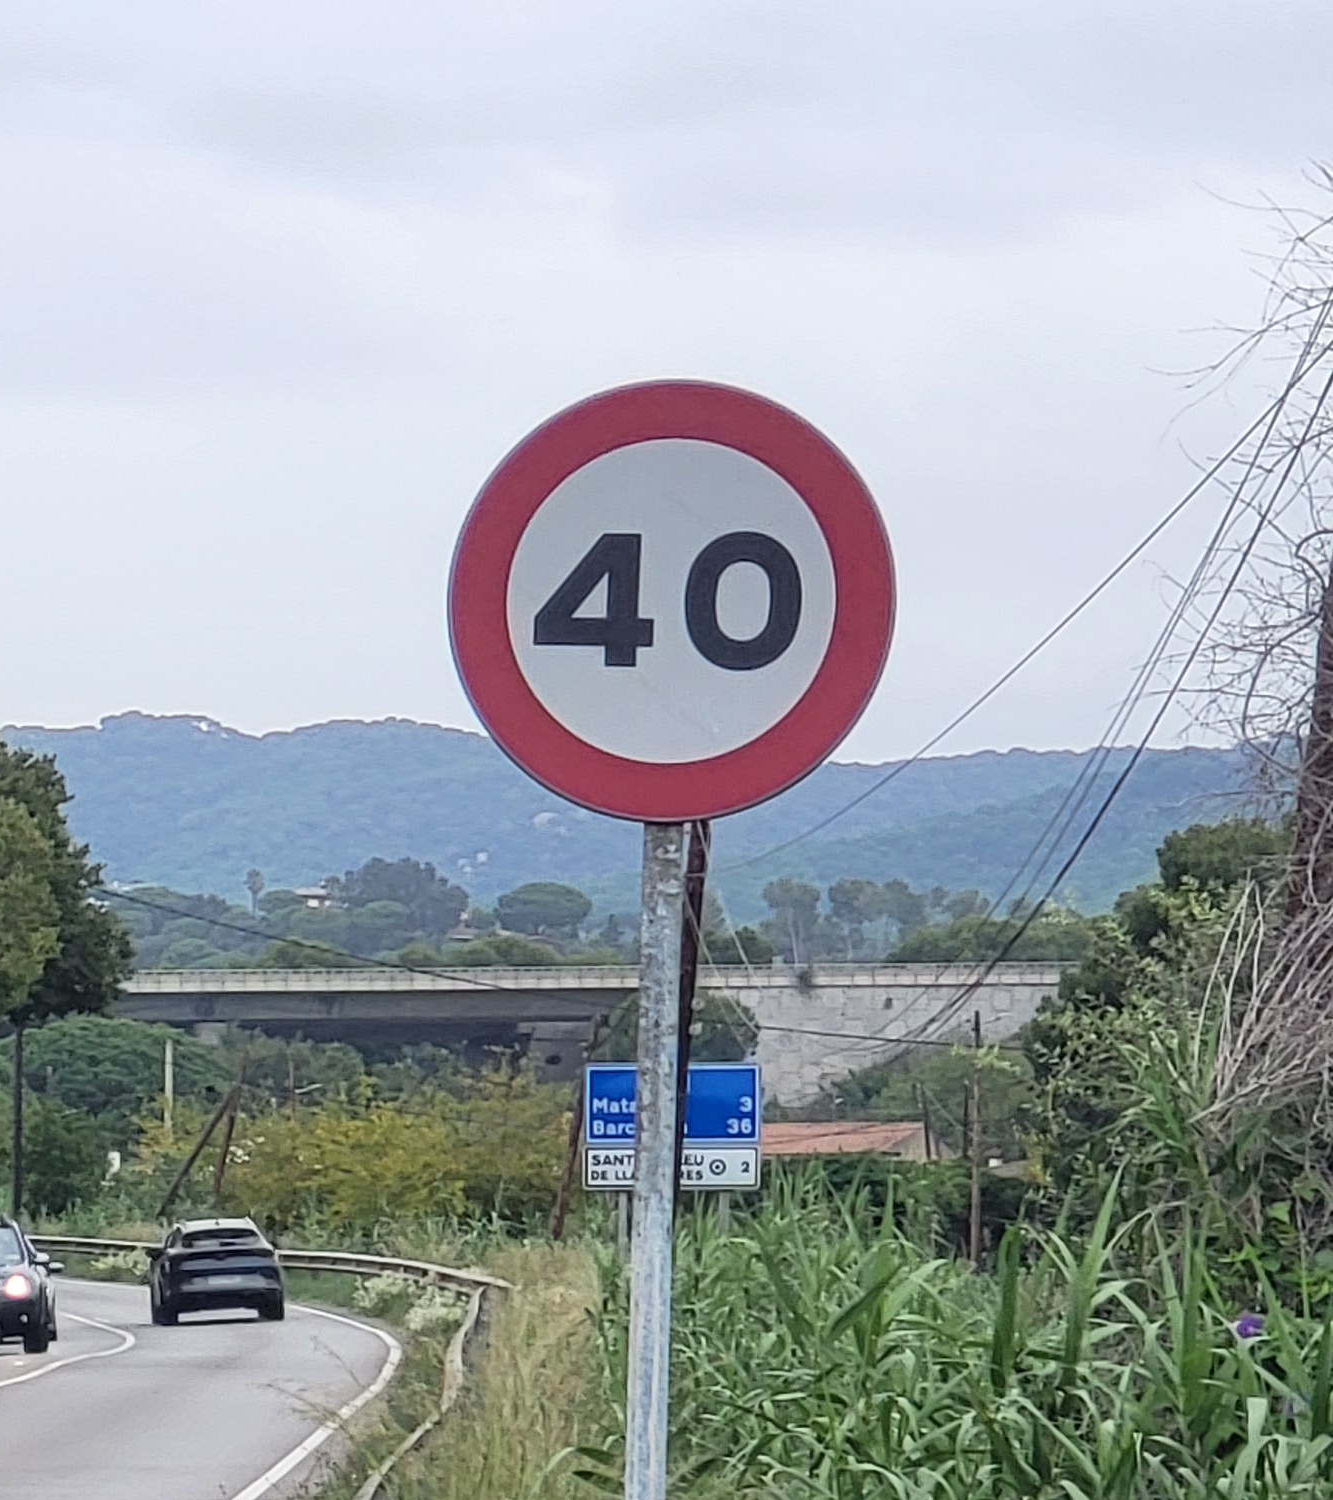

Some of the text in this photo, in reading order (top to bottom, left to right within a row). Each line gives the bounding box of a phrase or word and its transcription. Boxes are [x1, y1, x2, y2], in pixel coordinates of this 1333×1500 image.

[533, 531, 802, 671] 40
[593, 1096, 753, 1114] Mata 3
[726, 1118, 752, 1134] 36
[591, 1154, 635, 1166] SANT
[741, 1160, 750, 1173] 2
[591, 1170, 609, 1181] DE
